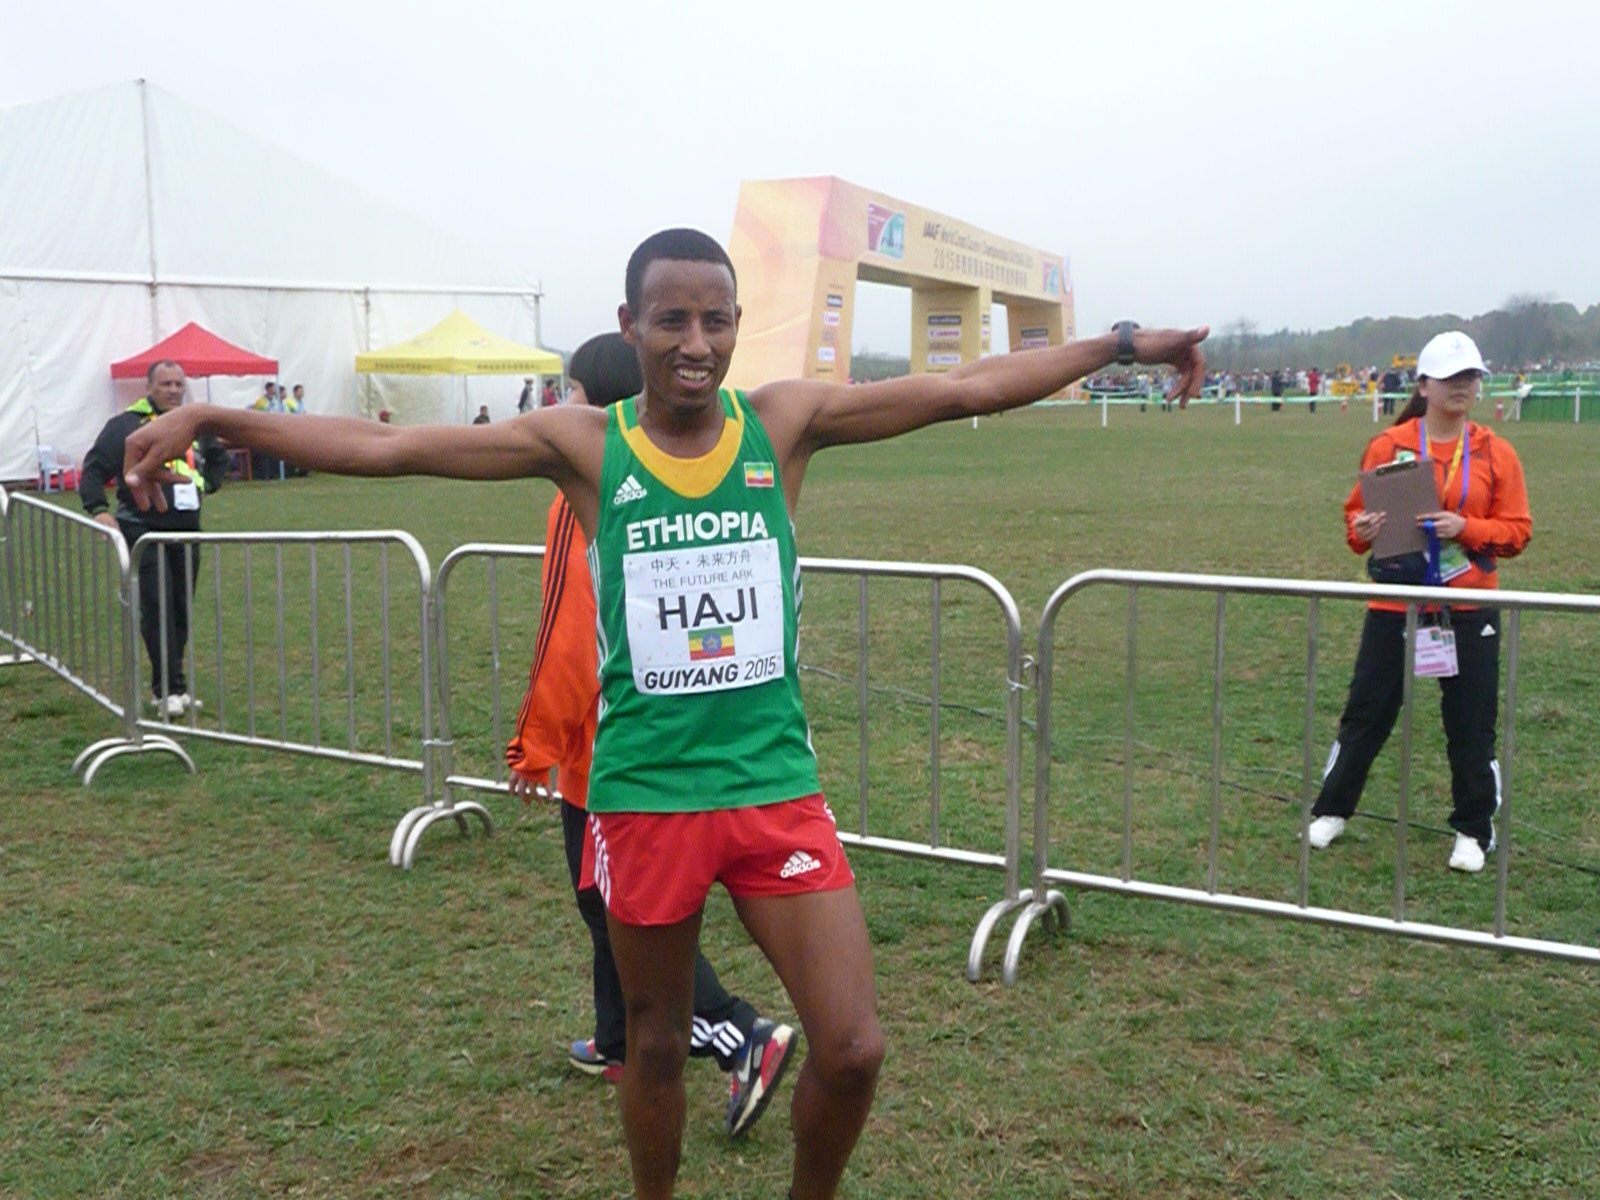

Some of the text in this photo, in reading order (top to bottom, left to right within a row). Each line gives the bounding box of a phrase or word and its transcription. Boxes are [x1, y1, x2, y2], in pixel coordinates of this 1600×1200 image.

[613, 487, 648, 506] adidas
[626, 511, 769, 550] ETHIOPIA
[652, 568, 754, 589] THE FUTURE ARK
[657, 587, 759, 630] HAJI
[644, 655, 777, 690] GUIYANG 2015
[780, 859, 821, 879] adidas
